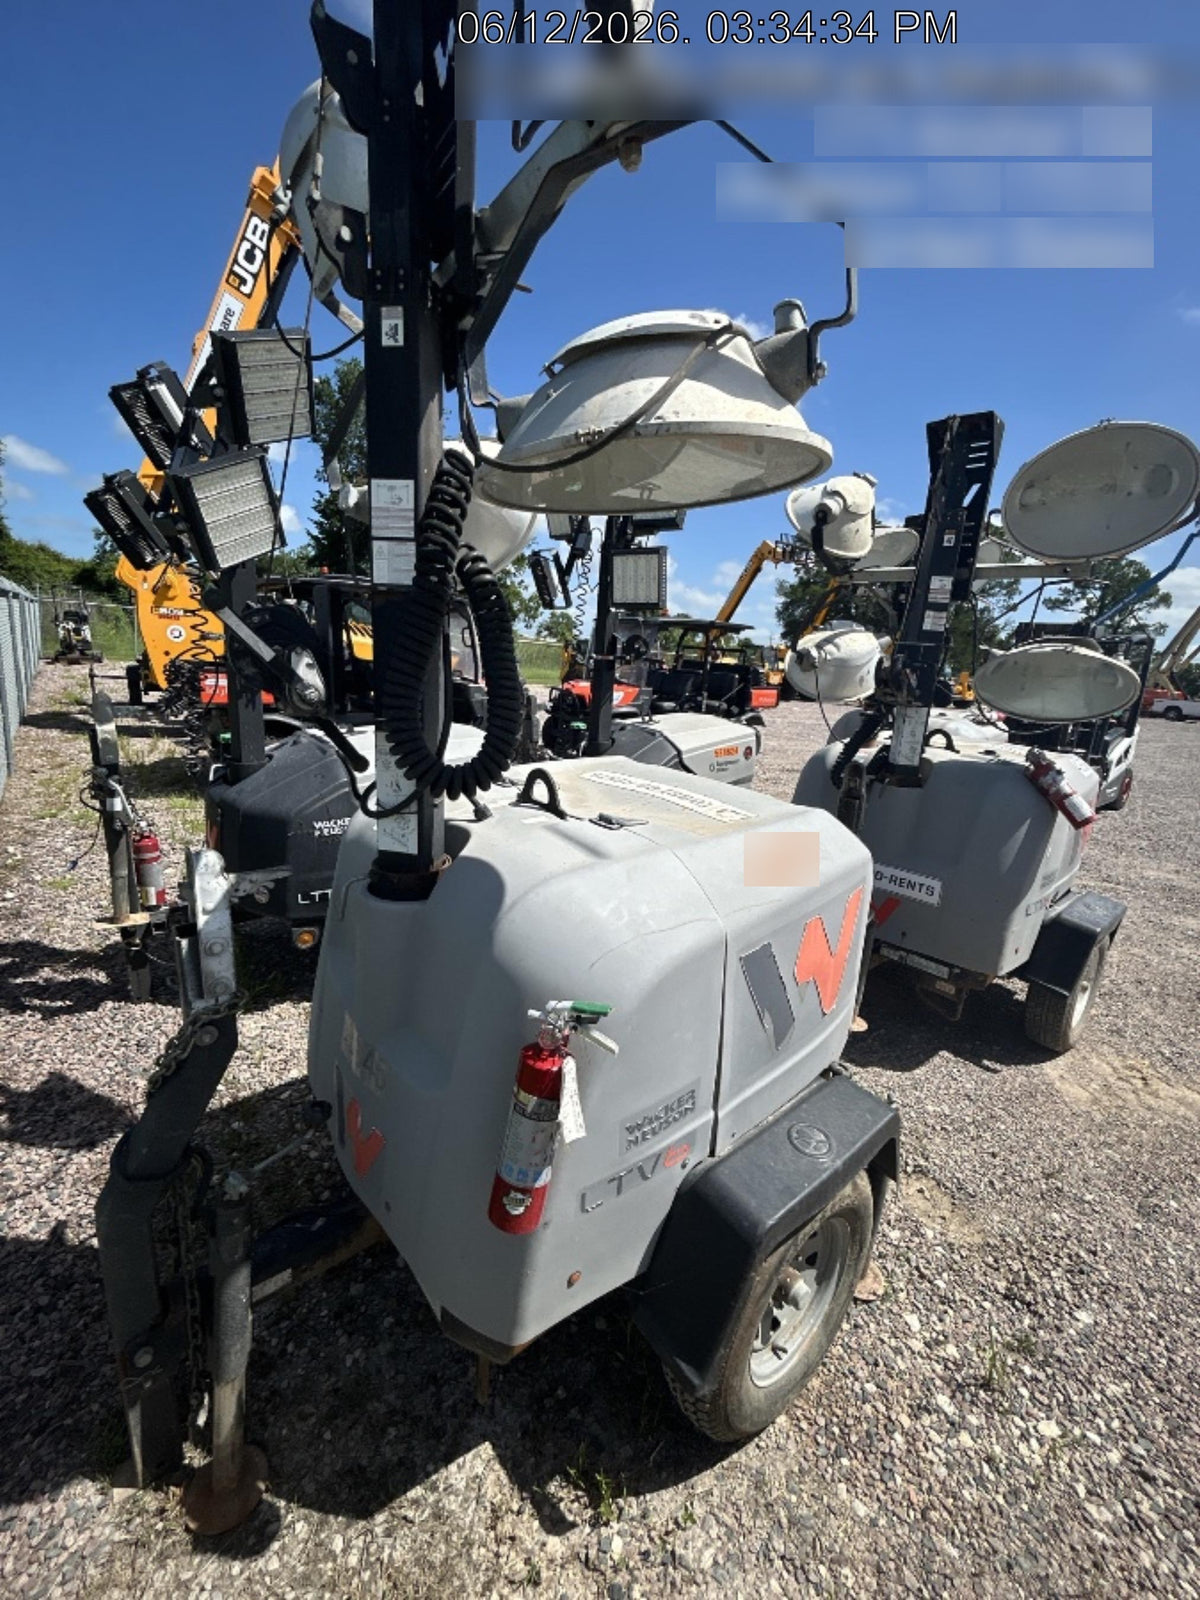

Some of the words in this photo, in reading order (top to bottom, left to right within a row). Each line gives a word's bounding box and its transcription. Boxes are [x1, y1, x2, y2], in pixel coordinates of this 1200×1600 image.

[232, 215, 270, 295] JCB
[218, 307, 236, 332] are
[312, 817, 351, 829] WACKE
[625, 1089, 695, 1135] WACKER
[626, 1102, 696, 1146] NEUSON
